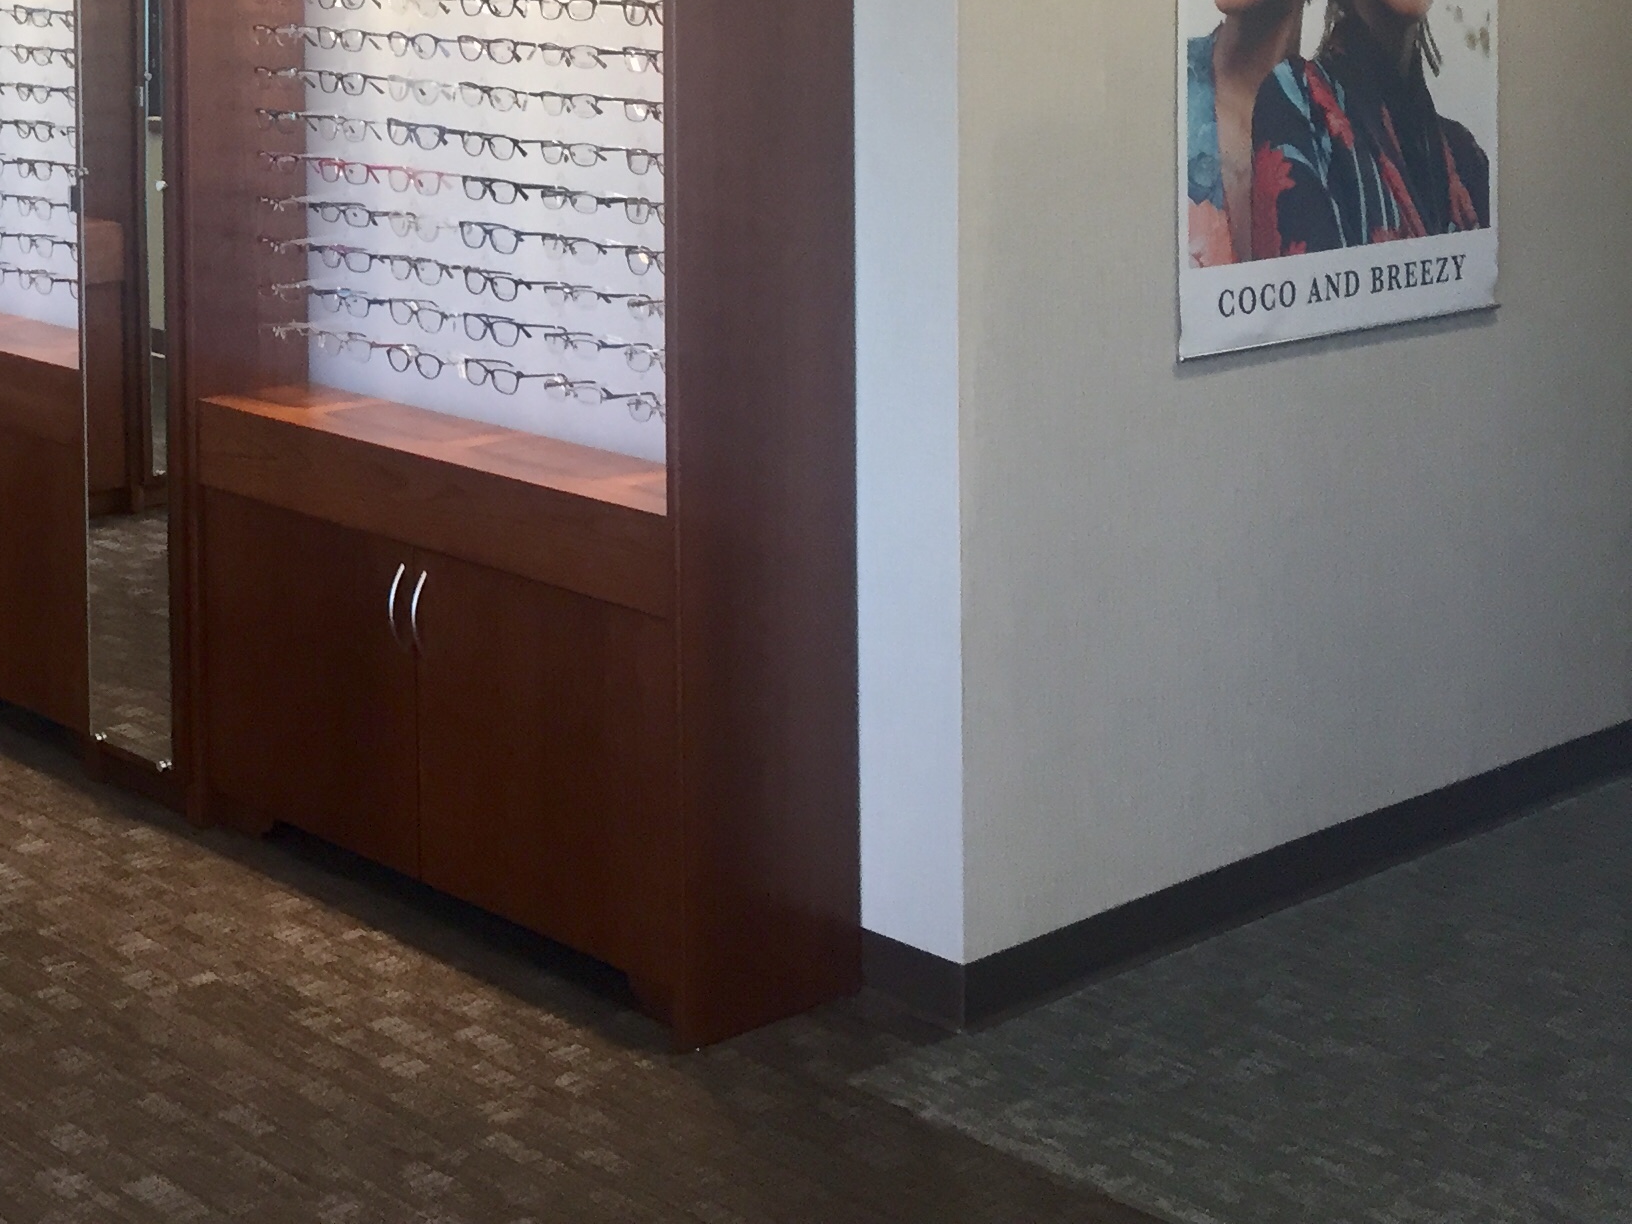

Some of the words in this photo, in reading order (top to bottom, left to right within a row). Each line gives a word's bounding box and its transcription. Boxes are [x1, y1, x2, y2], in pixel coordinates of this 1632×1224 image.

[1218, 279, 1297, 318] COCO
[1306, 269, 1360, 305] AND
[1370, 253, 1467, 295] BREEZY
